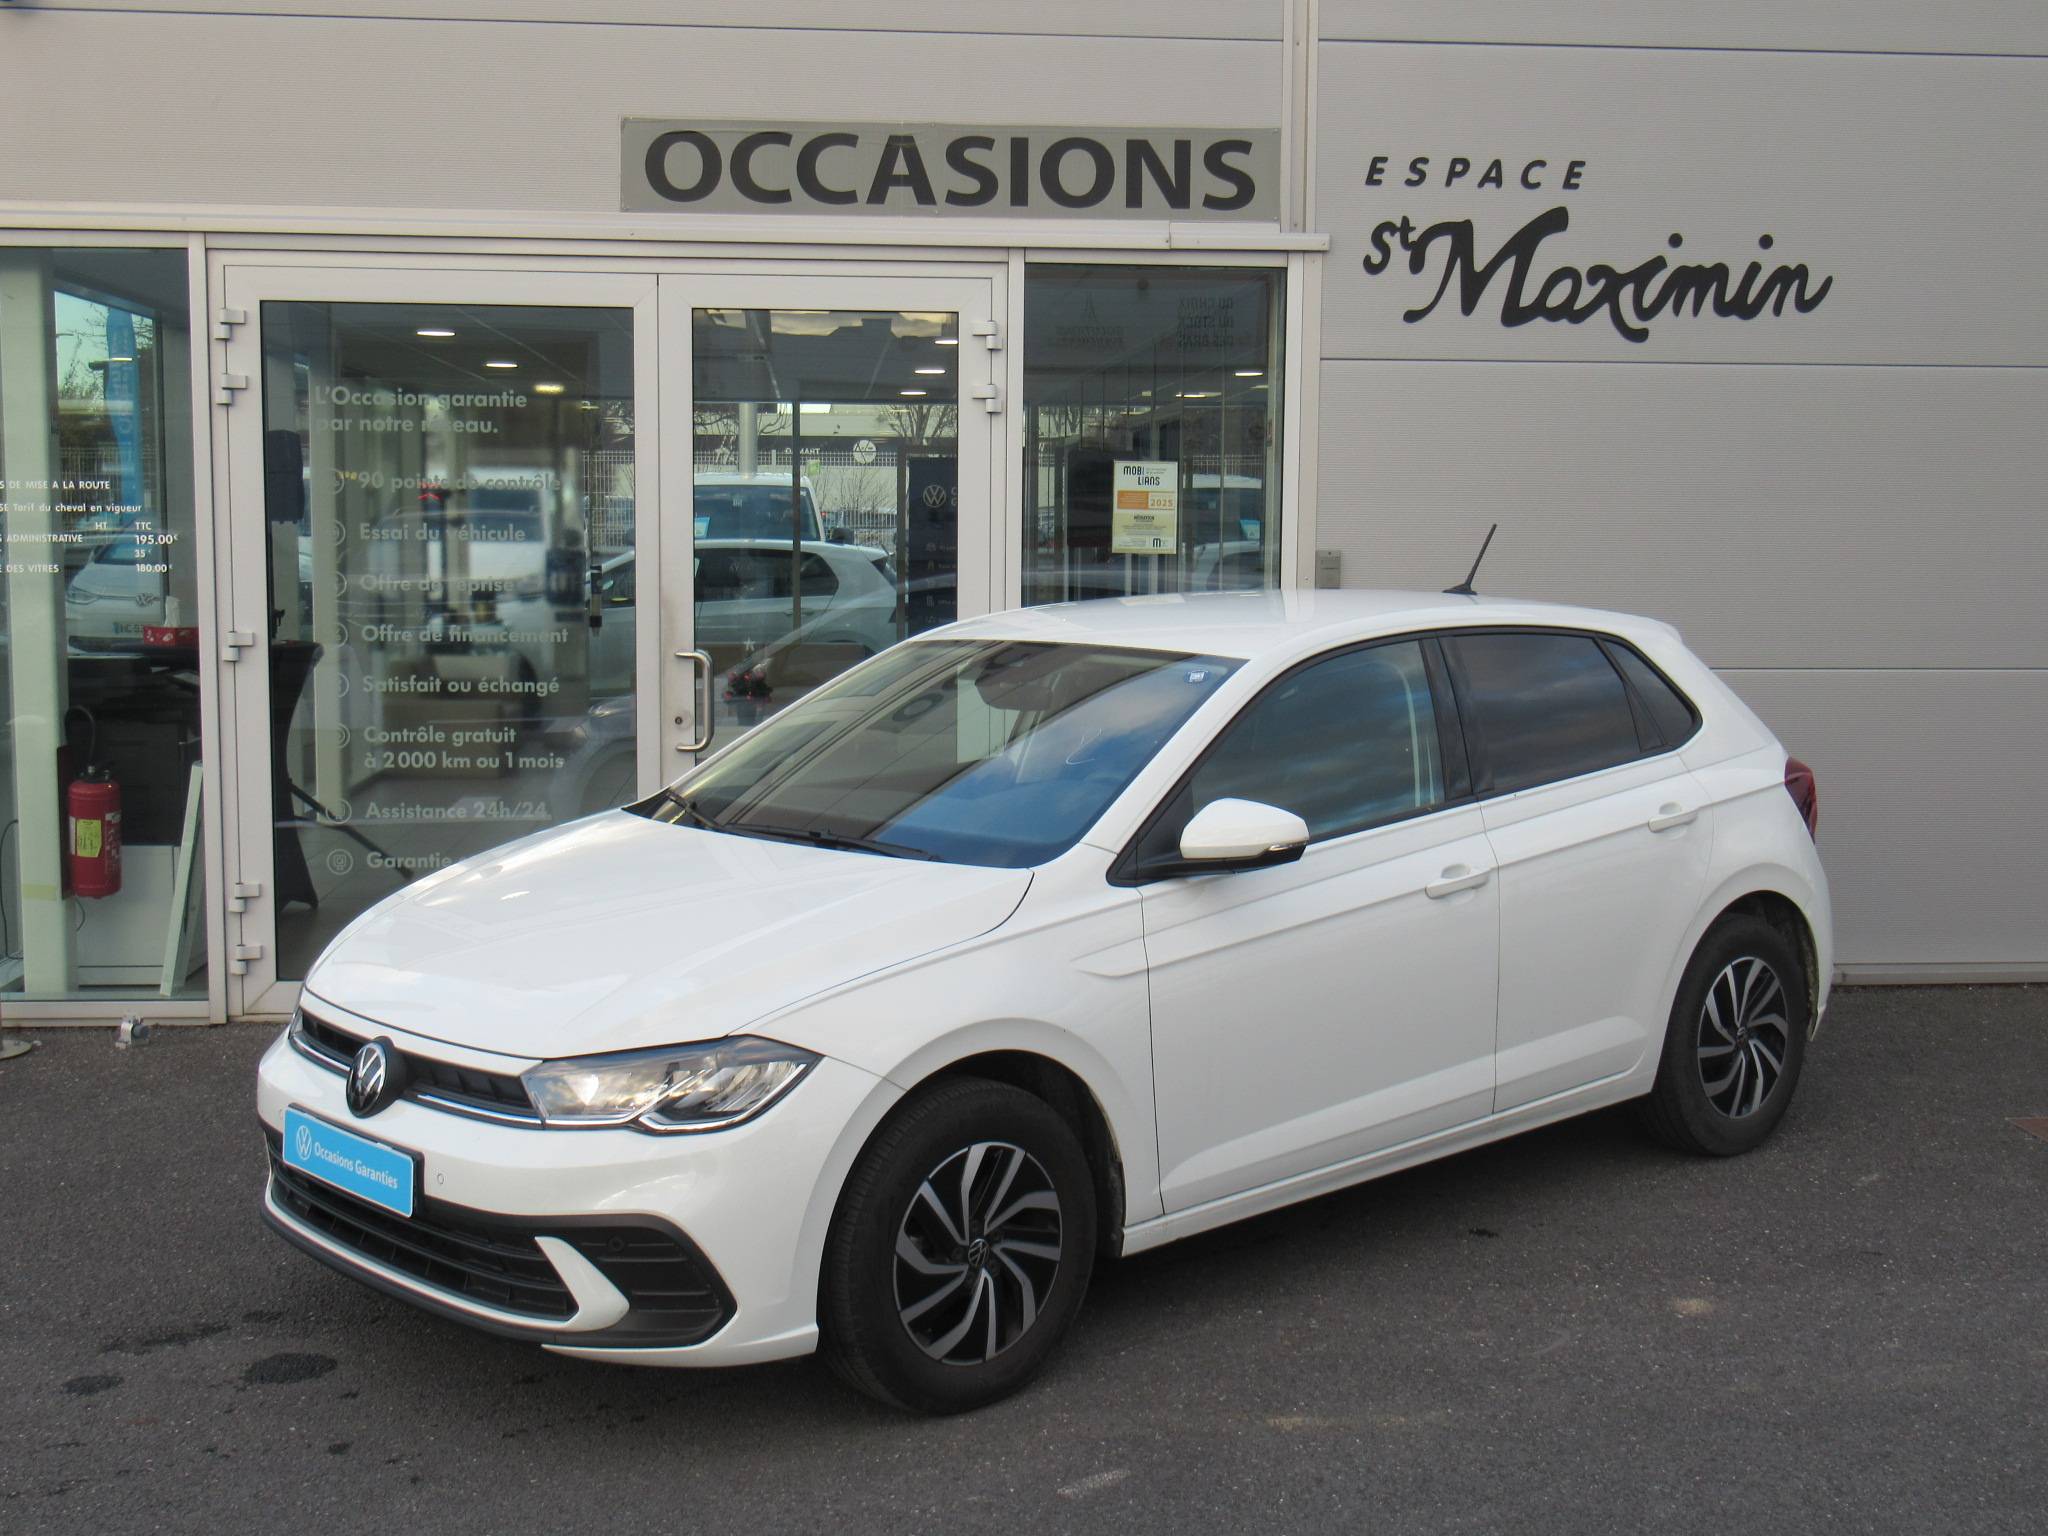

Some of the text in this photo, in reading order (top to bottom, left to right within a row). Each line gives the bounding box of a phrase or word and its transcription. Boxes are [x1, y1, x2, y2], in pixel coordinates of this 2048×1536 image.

[644, 130, 1256, 212] OCCASIONS
[1364, 156, 1586, 191] ESPACE
[1402, 206, 1833, 343] Maximin
[437, 389, 528, 410] garantie
[359, 417, 414, 433] notre
[26, 480, 49, 490] MISE
[52, 480, 59, 490] A
[62, 480, 75, 490] LA
[79, 480, 110, 490] ROUTE
[486, 471, 561, 491] contrôle
[13, 503, 35, 512] Tarif
[39, 503, 51, 512] du
[55, 503, 86, 512] cheval
[90, 504, 102, 513] en
[106, 503, 143, 514] vigueur
[1150, 498, 1174, 508] 2025
[135, 521, 152, 531] TTC
[360, 522, 409, 541] Essai
[415, 522, 440, 541] du
[7, 533, 83, 543] ADMINISTRATIVE
[6, 564, 25, 573] DES
[28, 564, 60, 574] VITRES
[360, 574, 411, 592] Offre
[418, 574, 442, 592] de
[361, 624, 569, 644] Offre de financement
[362, 675, 560, 697] Satisfait ou échangé
[364, 726, 517, 747] Contrôle gratuit
[364, 753, 377, 769] à
[442, 751, 471, 769] km
[476, 756, 500, 769] ou
[506, 752, 513, 769] 1
[518, 753, 565, 769] mois
[365, 801, 467, 819] Assistance
[366, 851, 453, 869] Garantie
[314, 1141, 354, 1173] Occasions
[355, 1160, 399, 1190] Garanties
